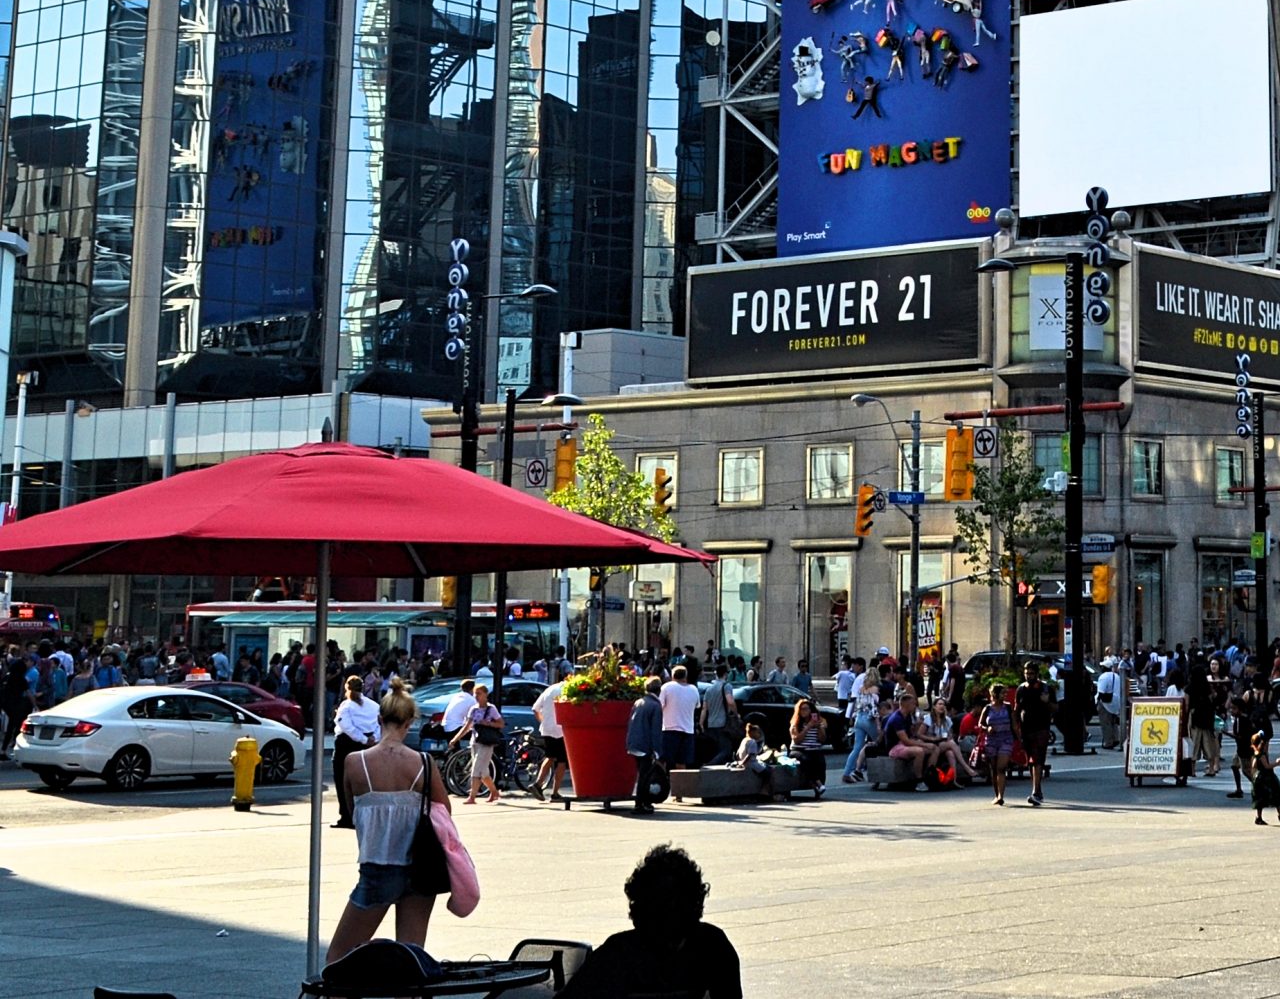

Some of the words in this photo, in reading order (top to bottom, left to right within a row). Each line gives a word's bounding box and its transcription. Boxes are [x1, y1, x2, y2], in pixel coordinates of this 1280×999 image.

[817, 147, 863, 175] FUN
[869, 136, 962, 168] MAGNET
[966, 206, 991, 220] OLG
[786, 230, 802, 244] Play
[803, 228, 827, 241] Smart
[1086, 187, 1108, 325] Yonge
[445, 238, 469, 361] Yonge
[731, 279, 879, 335] FOREVER
[897, 274, 932, 322] 21
[1066, 262, 1074, 359] DOWNTOWN
[1156, 281, 1186, 315] LIKE
[1188, 287, 1202, 318] IT.
[1204, 290, 1241, 324] WEAR
[1243, 296, 1255, 327] IT.
[462, 301, 473, 388] DOWNTOWN
[788, 333, 866, 350] FOREVER21.COM
[1235, 353, 1251, 439] Yonge
[919, 619, 937, 637] OW
[1135, 705, 1179, 716] CAUTION
[1132, 755, 1174, 763] CONDITIONS
[1135, 747, 1173, 755] SLIPPERY
[1134, 763, 1155, 771] WHEN
[1156, 763, 1171, 771] WET
